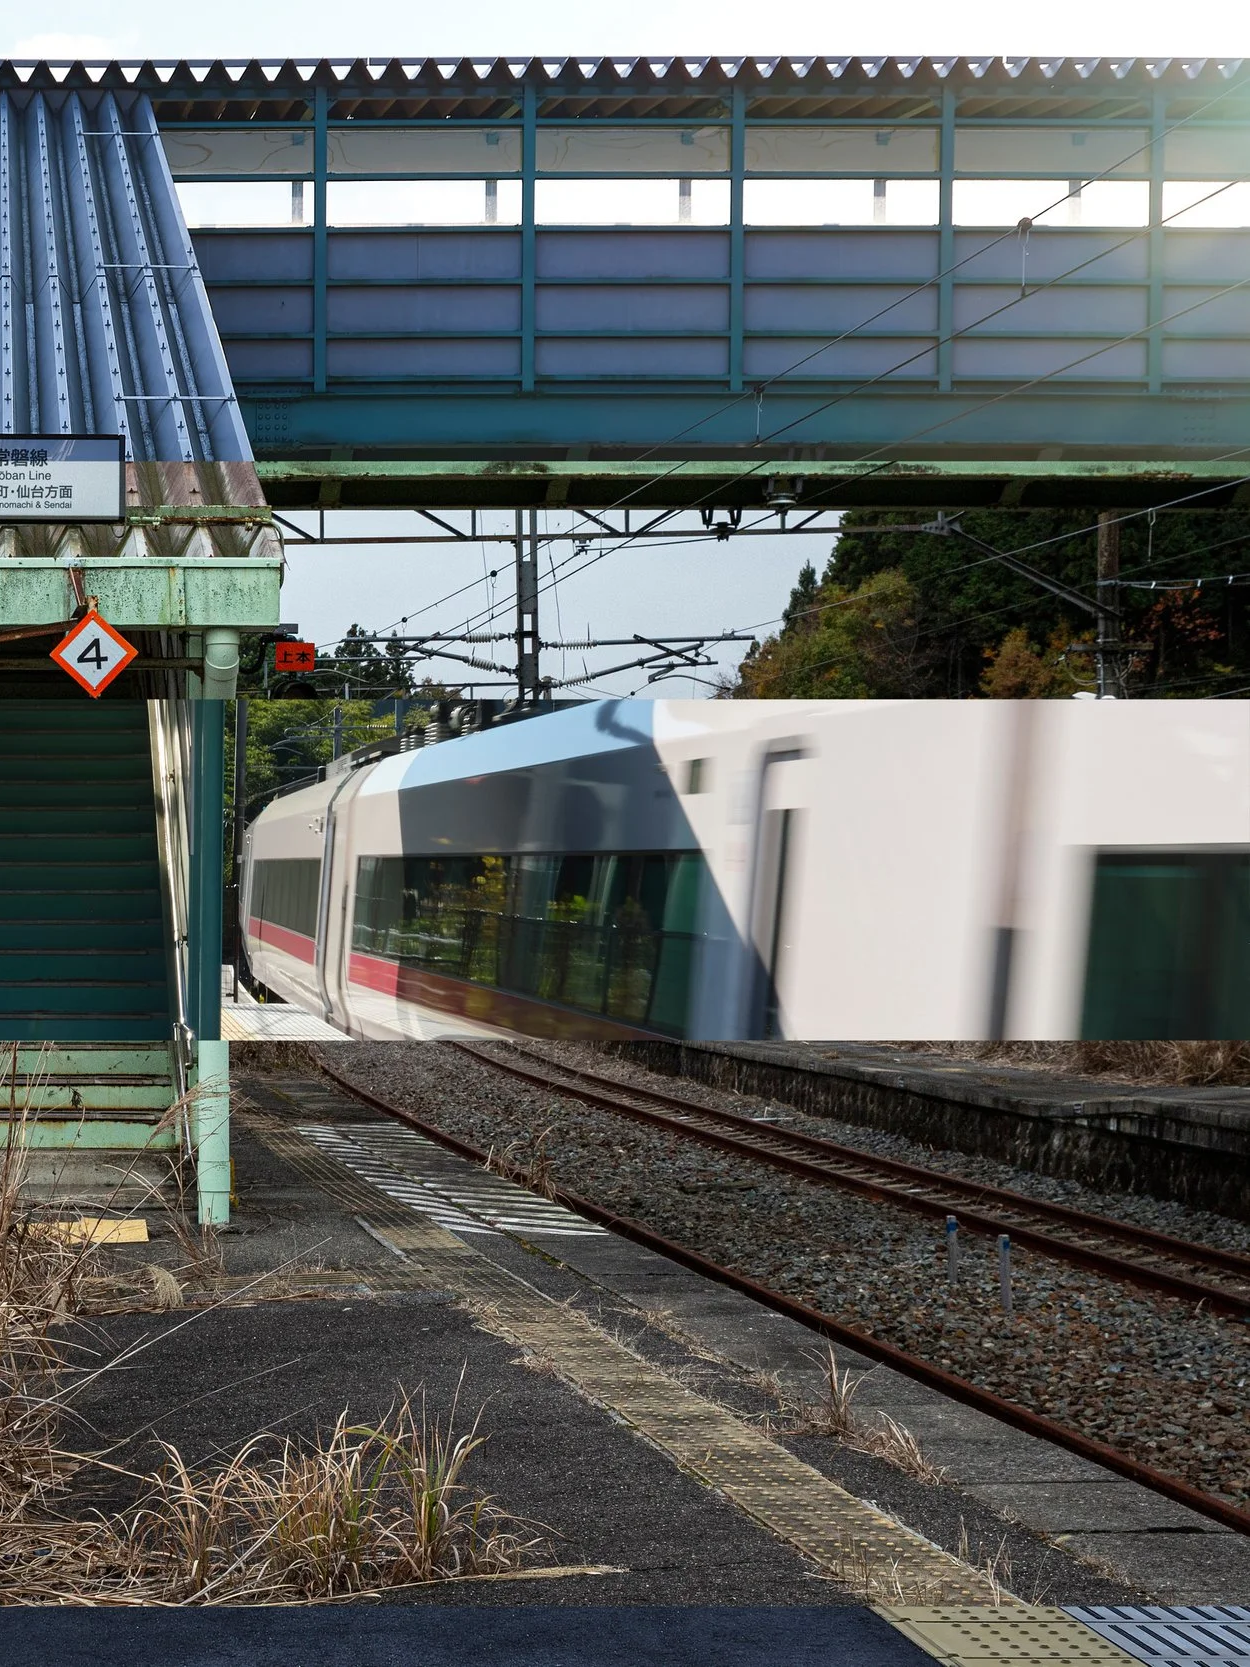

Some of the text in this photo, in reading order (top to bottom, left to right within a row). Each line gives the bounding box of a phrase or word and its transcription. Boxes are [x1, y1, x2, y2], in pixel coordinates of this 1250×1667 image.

[28, 470, 52, 481] Line
[35, 501, 41, 509] &
[44, 501, 72, 509] Sendai
[76, 637, 109, 670] 4
[278, 651, 312, 664] 上本
